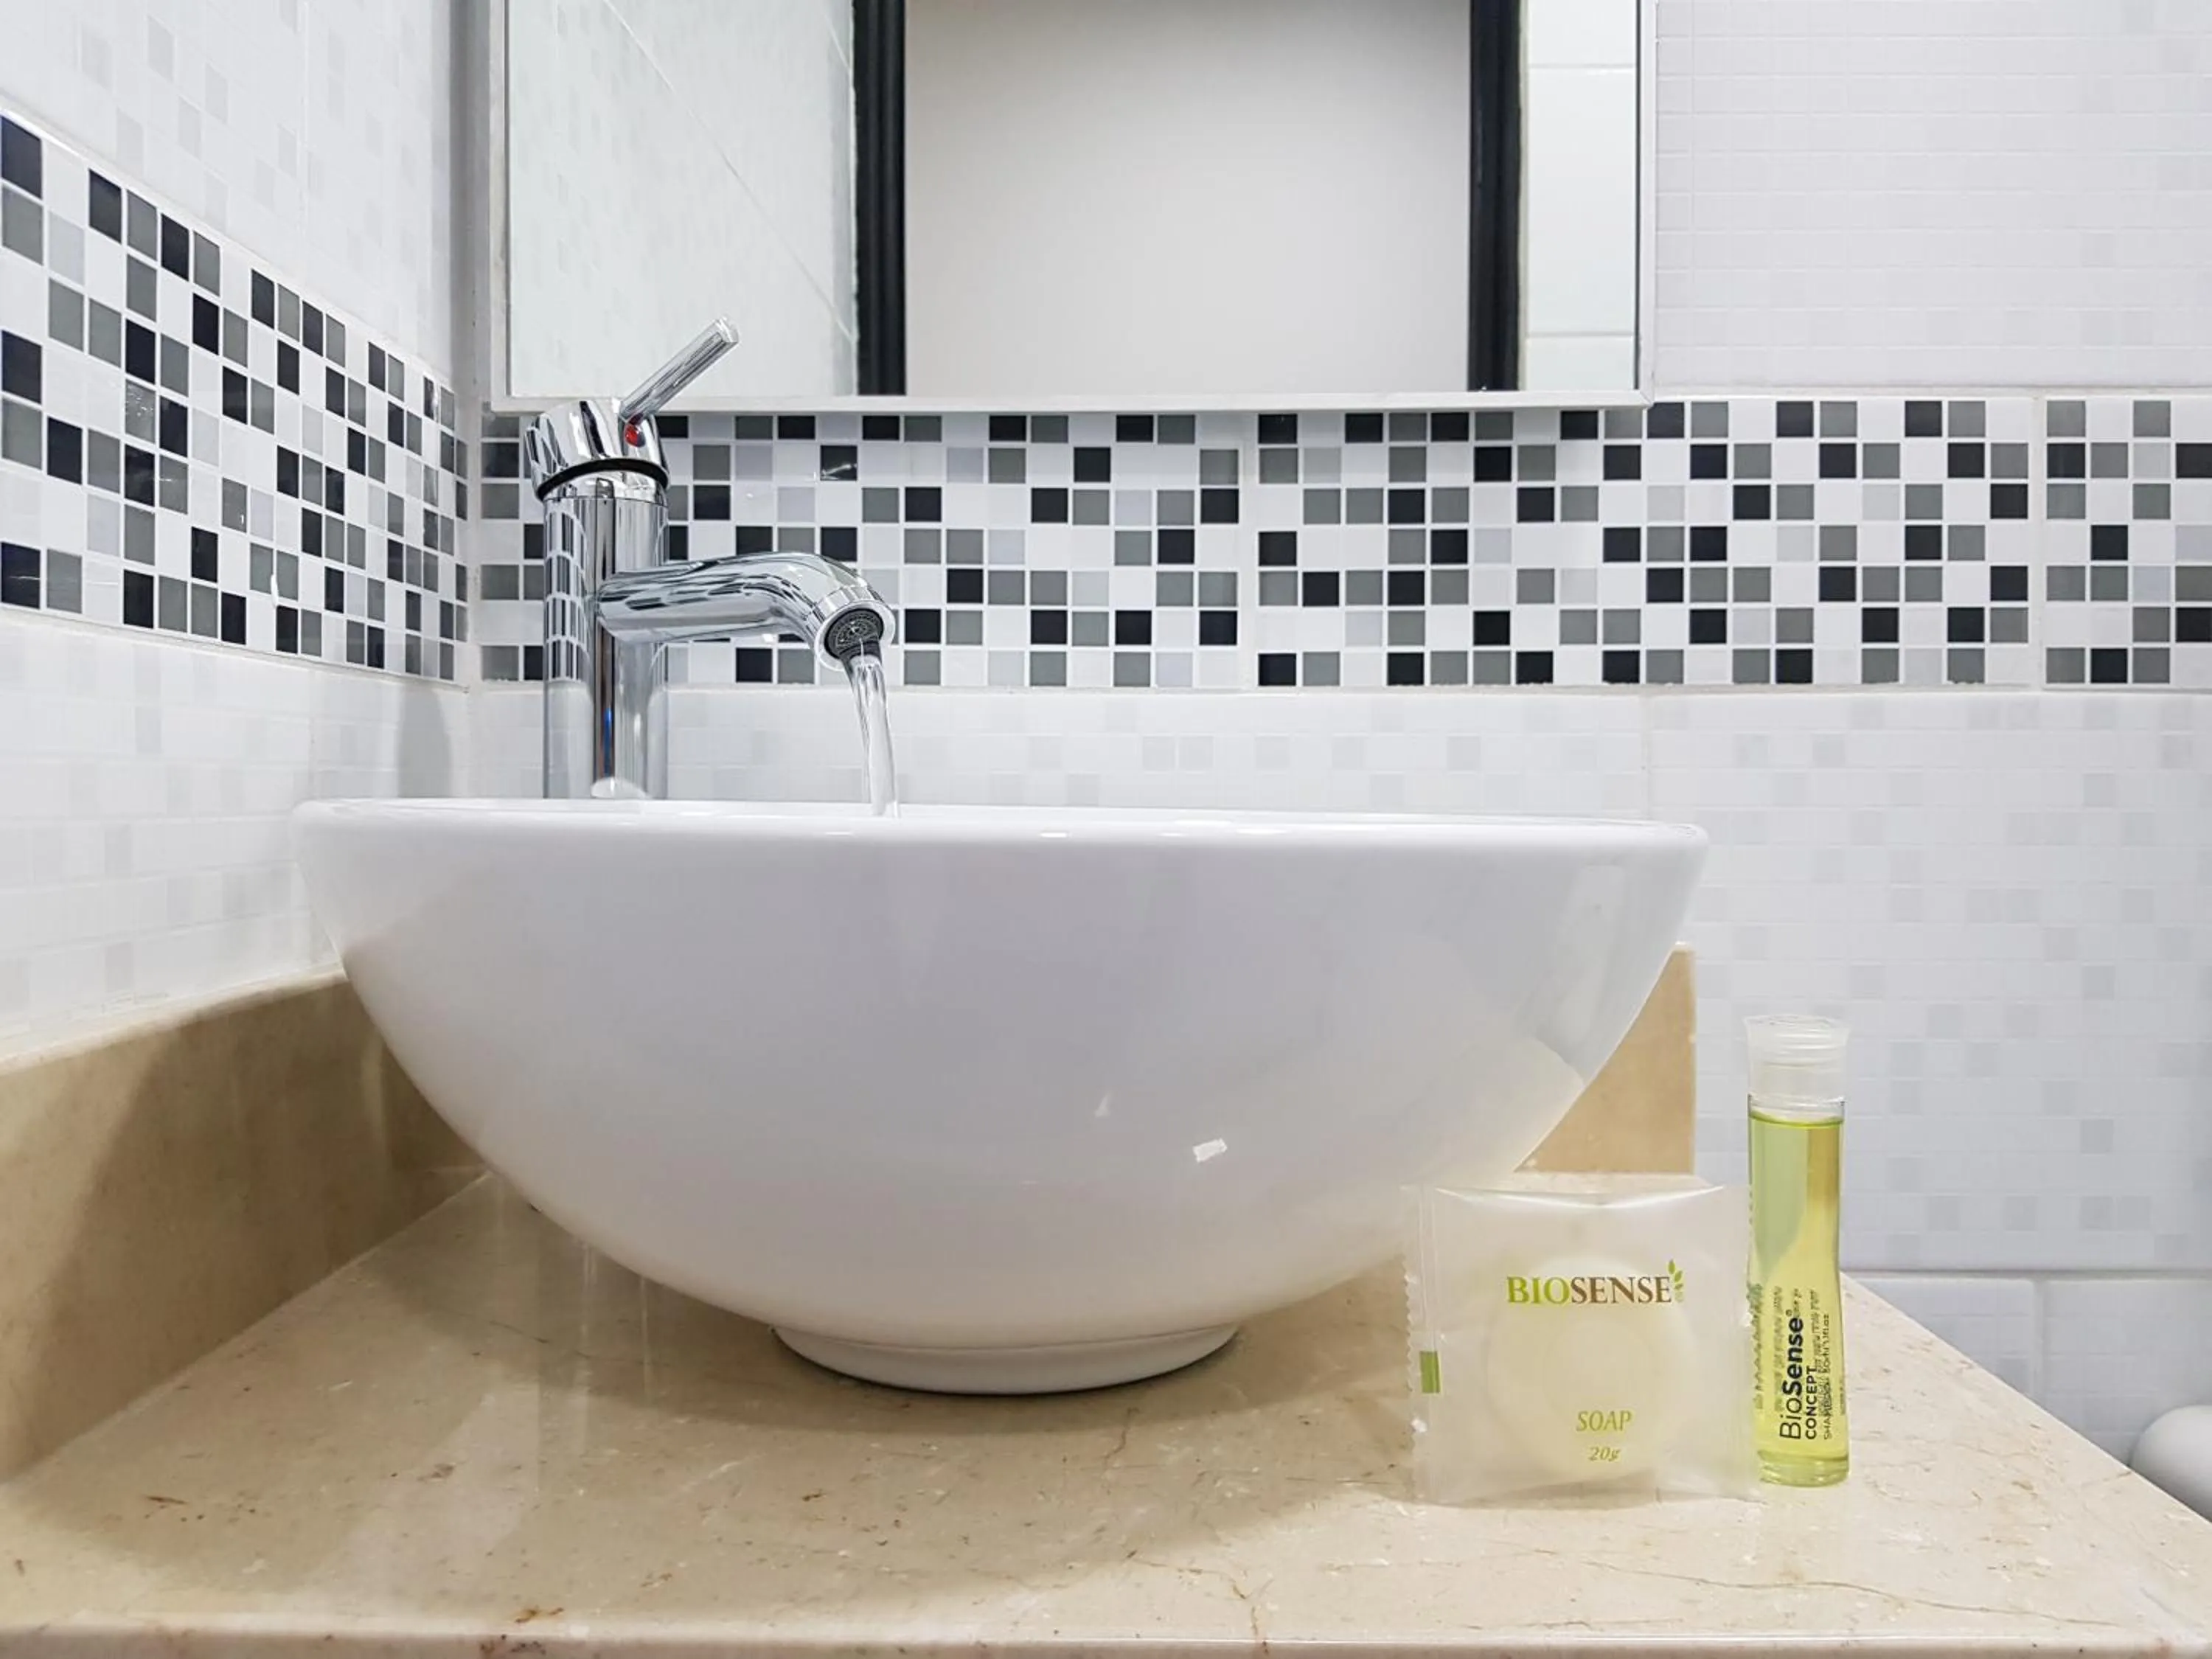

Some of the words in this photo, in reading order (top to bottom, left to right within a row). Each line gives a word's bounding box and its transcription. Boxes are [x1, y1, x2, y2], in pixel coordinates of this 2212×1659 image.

[1506, 1276, 1673, 1304] BIOSENSE
[1806, 1364, 1818, 1441] CONCEPT
[1575, 1410, 1633, 1432] SOAP
[1588, 1446, 1621, 1462] 20g
